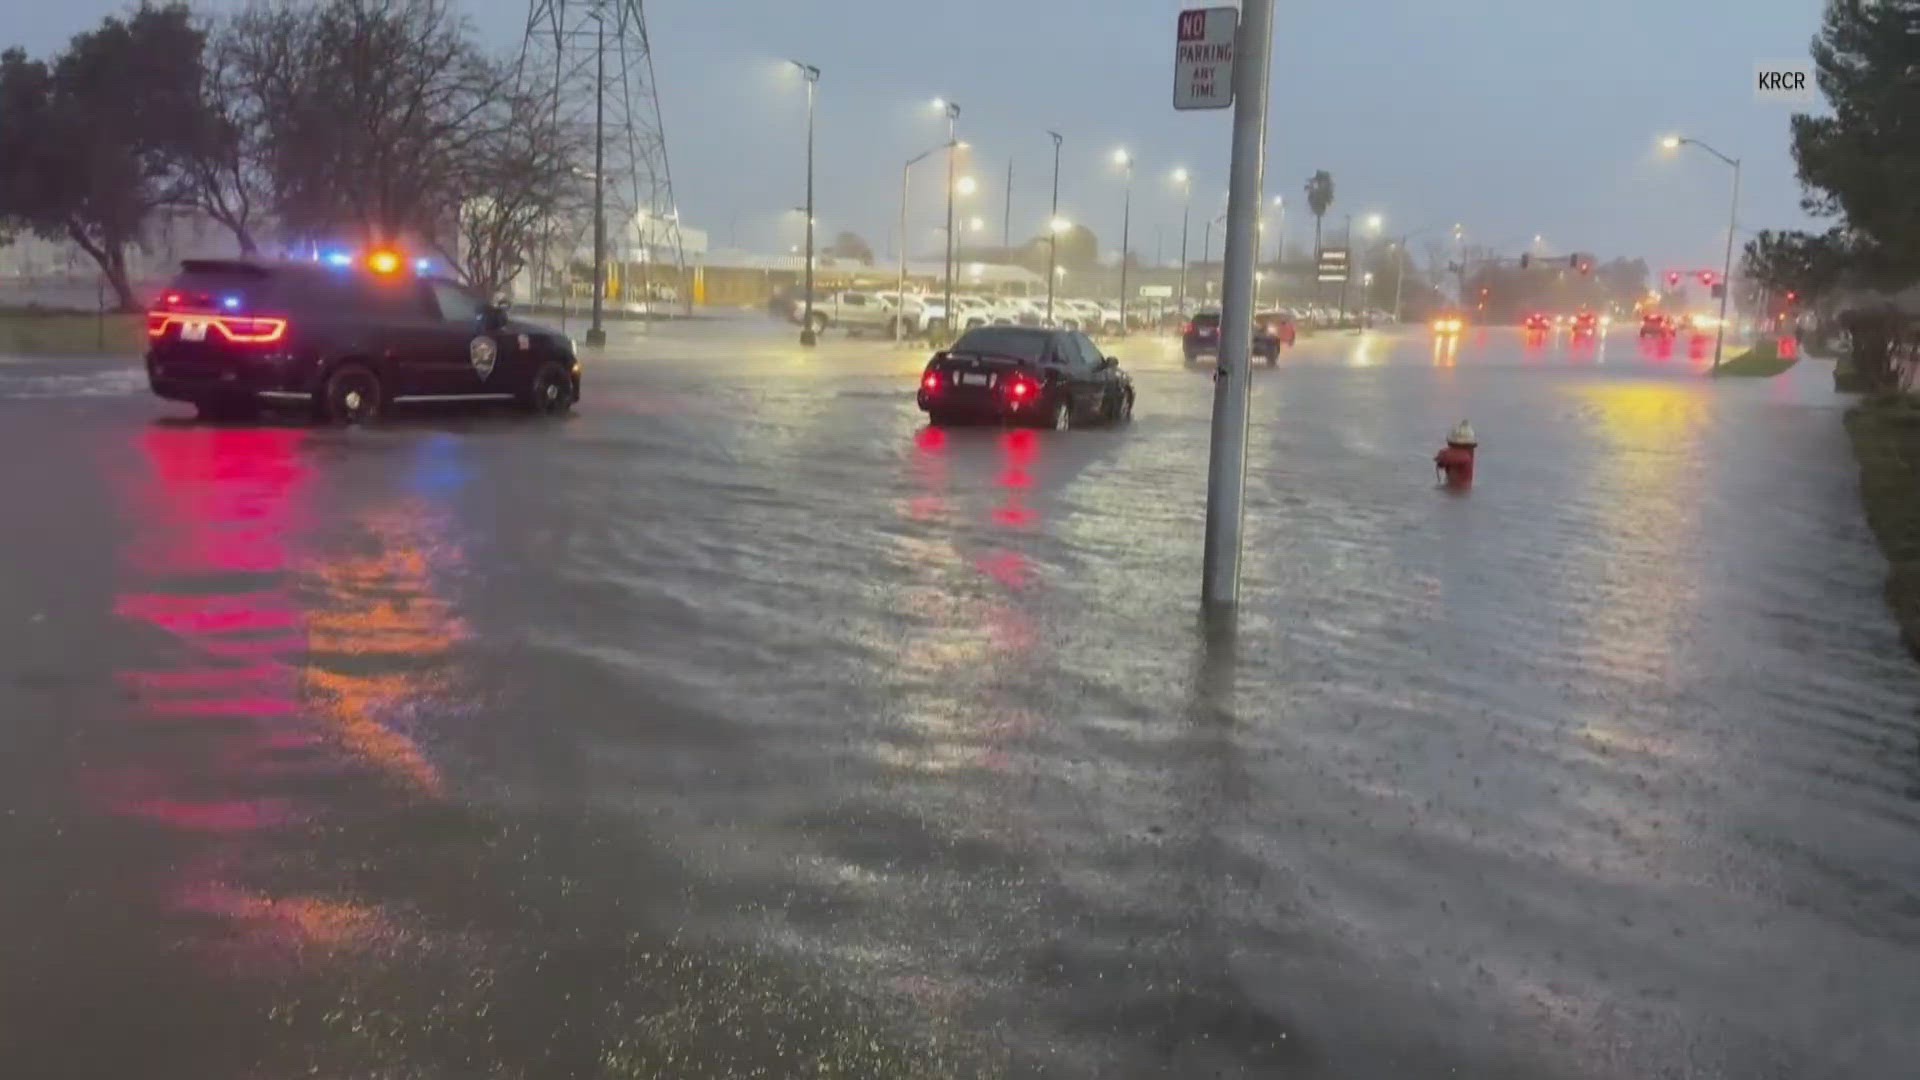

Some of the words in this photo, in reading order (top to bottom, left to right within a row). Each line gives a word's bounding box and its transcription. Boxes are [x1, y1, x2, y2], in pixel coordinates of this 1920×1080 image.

[1182, 14, 1203, 37] NO
[1180, 44, 1232, 62] PARKING
[1193, 67, 1215, 81] ANY
[1191, 84, 1215, 98] TIME
